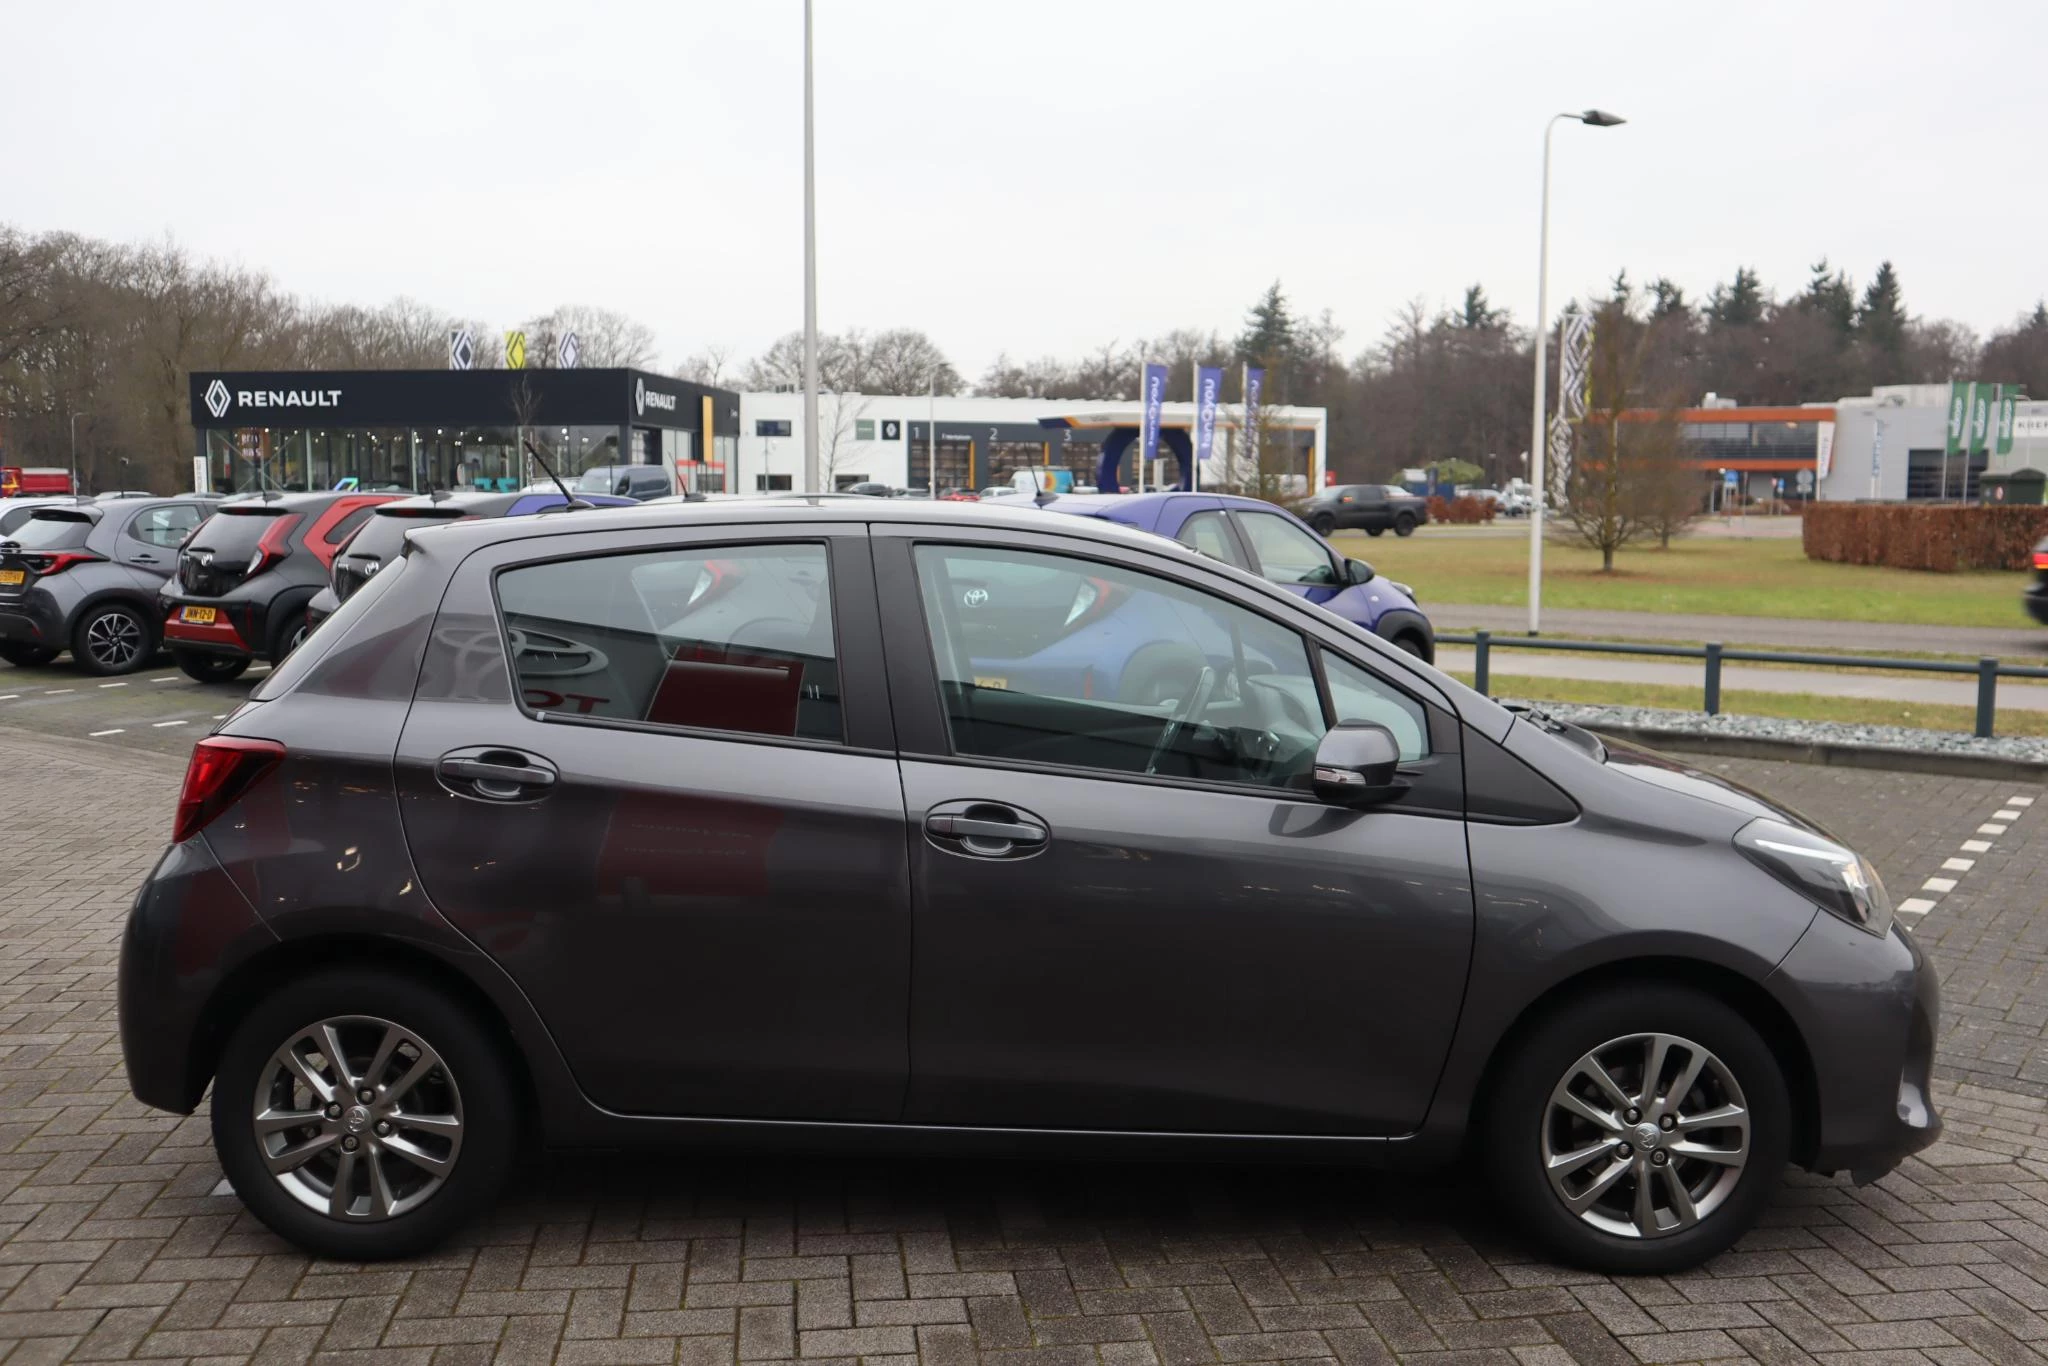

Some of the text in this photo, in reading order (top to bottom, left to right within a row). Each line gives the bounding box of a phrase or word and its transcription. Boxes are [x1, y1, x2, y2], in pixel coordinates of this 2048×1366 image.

[237, 390, 342, 407] RENAULT
[645, 391, 676, 411] RENAULT
[912, 426, 920, 440] 1
[989, 427, 998, 440] 2
[1063, 428, 1072, 441] 3
